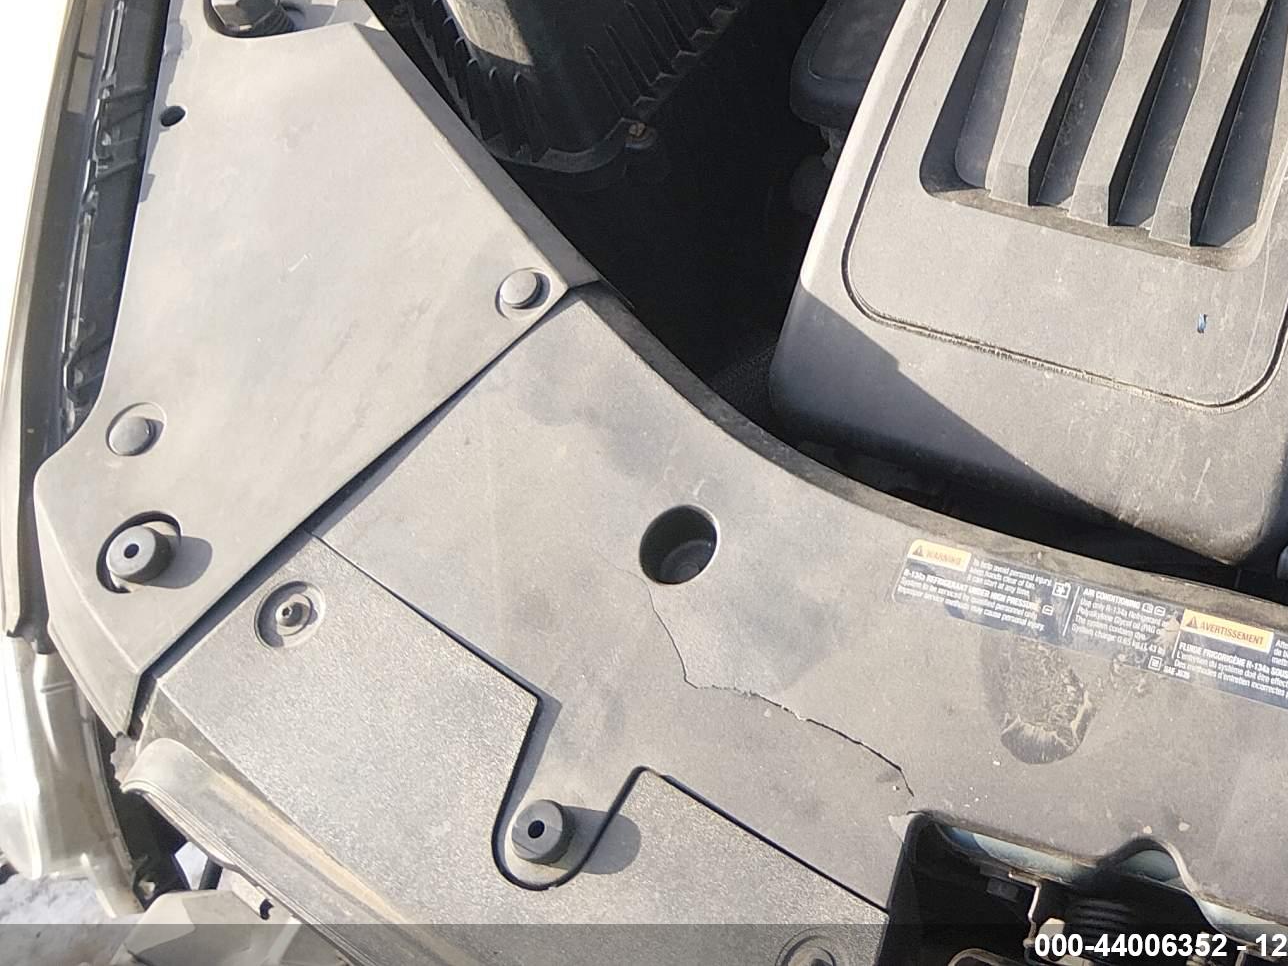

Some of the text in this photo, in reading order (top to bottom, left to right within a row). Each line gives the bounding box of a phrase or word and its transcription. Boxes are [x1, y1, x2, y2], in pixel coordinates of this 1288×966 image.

[1083, 588, 1141, 609] AIR CONDITIONING
[1200, 621, 1264, 647] AVERTISSEMENT
[1179, 642, 1202, 655] FLUIDE
[1246, 660, 1271, 674] R-134a
